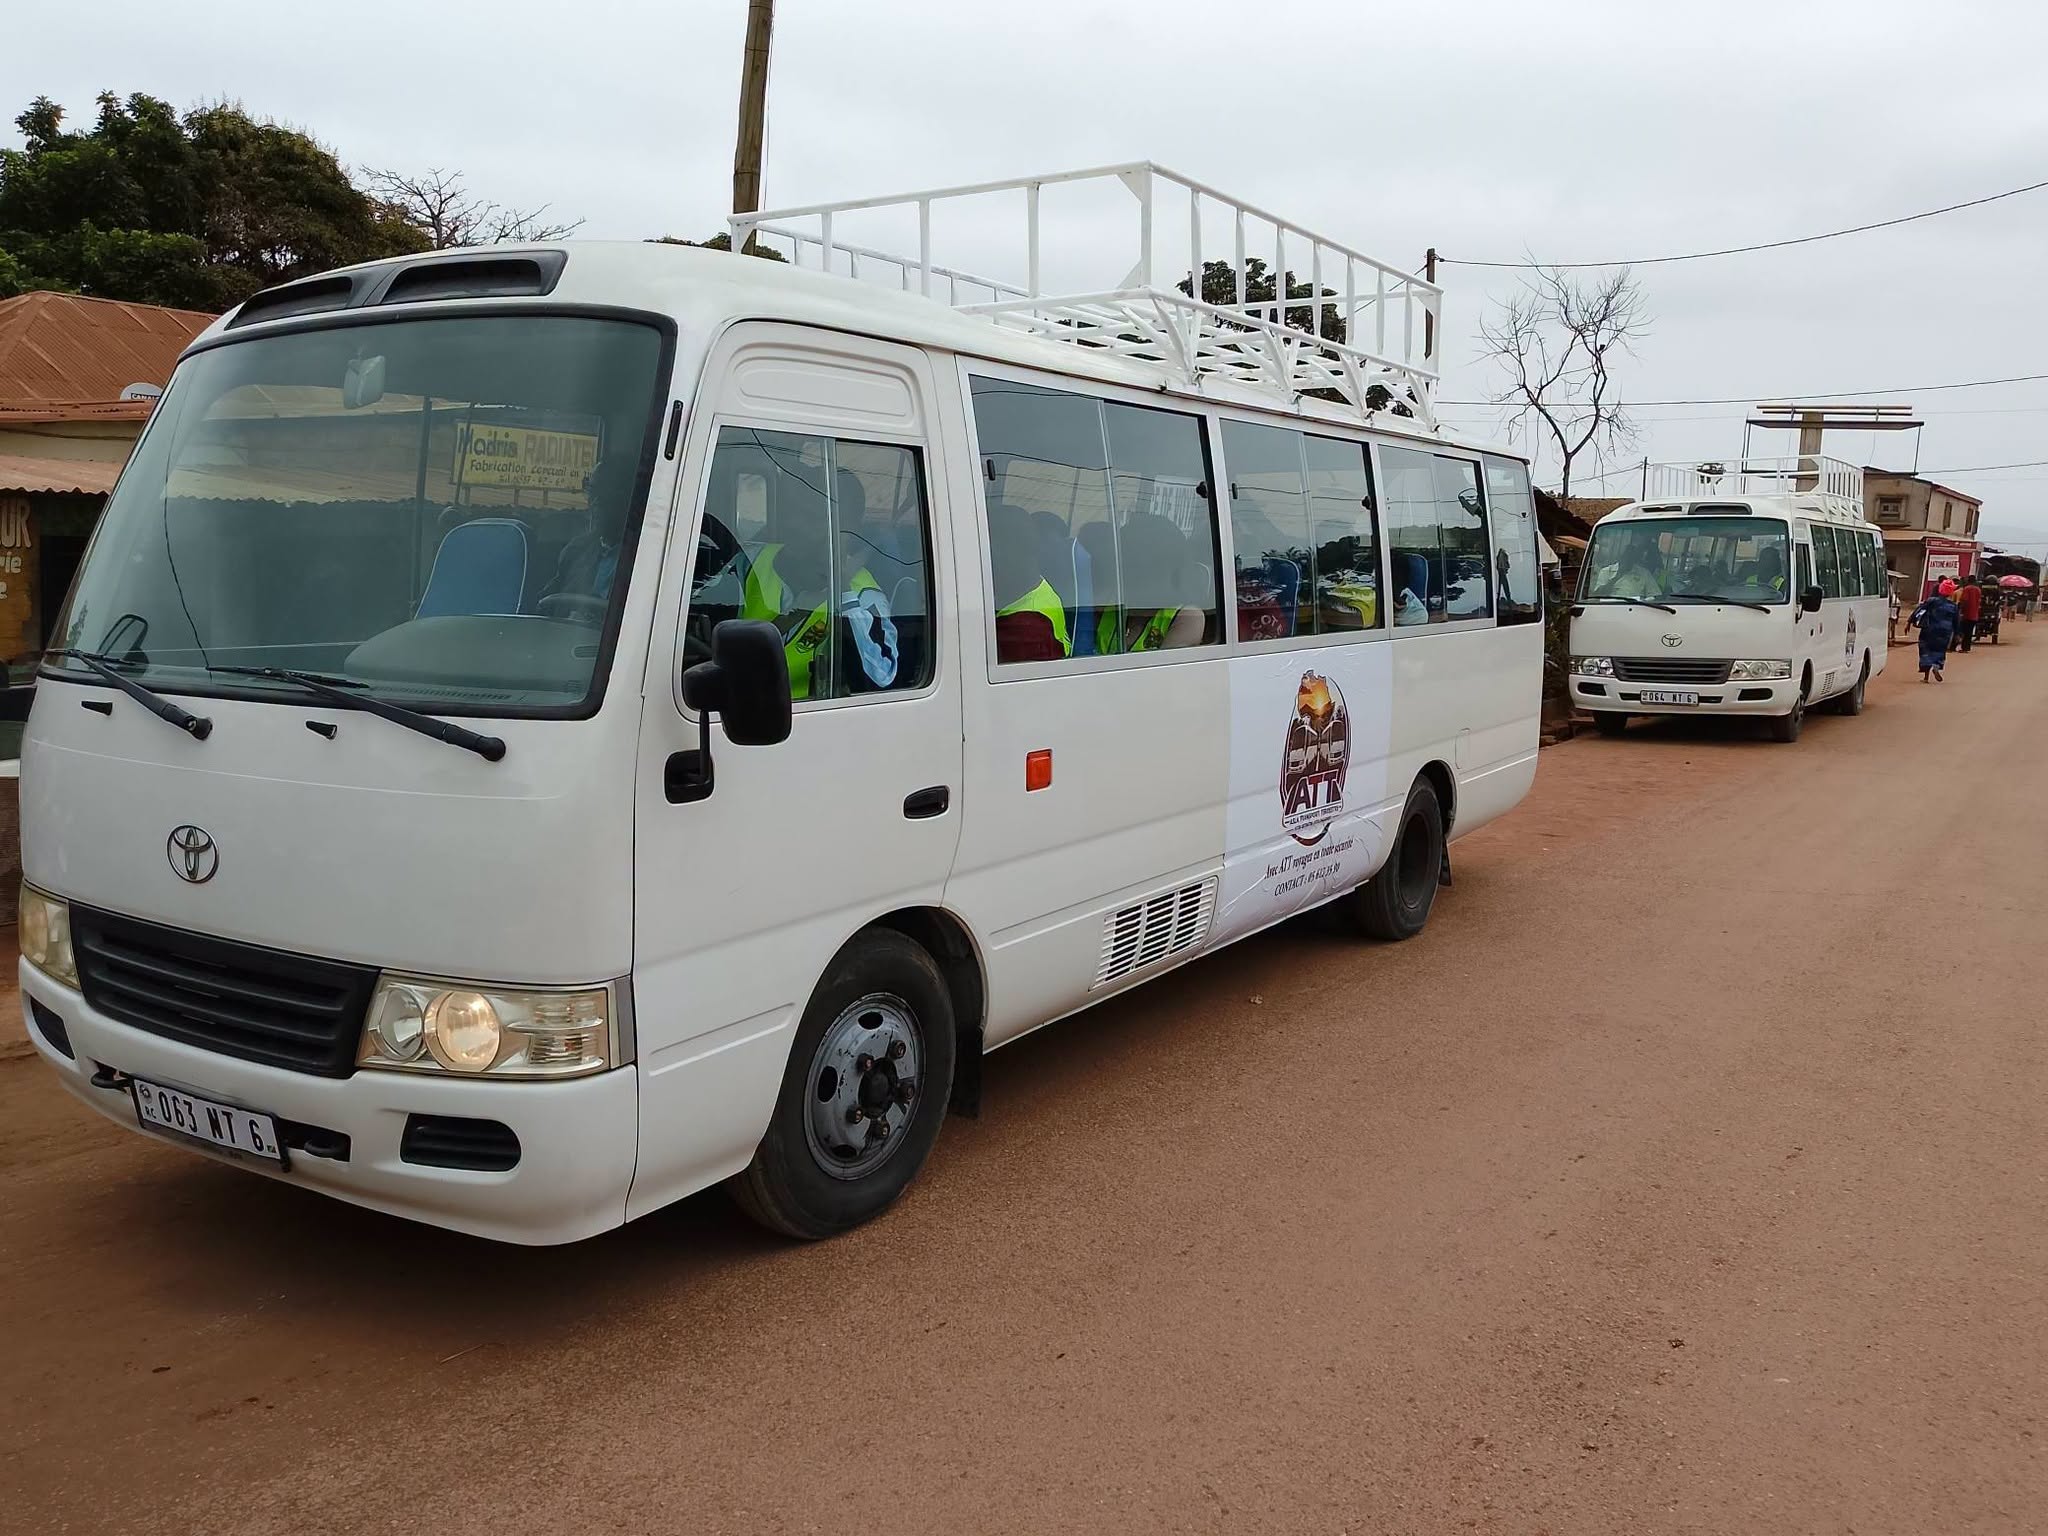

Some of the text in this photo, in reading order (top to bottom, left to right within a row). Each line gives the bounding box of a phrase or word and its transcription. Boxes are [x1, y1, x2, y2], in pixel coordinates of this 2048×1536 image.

[470, 459, 527, 476] Fabrication
[0, 501, 32, 548] UR
[1648, 692, 1693, 703] 064 NT 6
[1290, 769, 1338, 815] ATT
[1279, 854, 1294, 874] ATT
[158, 1091, 265, 1152] 063 NT 6
